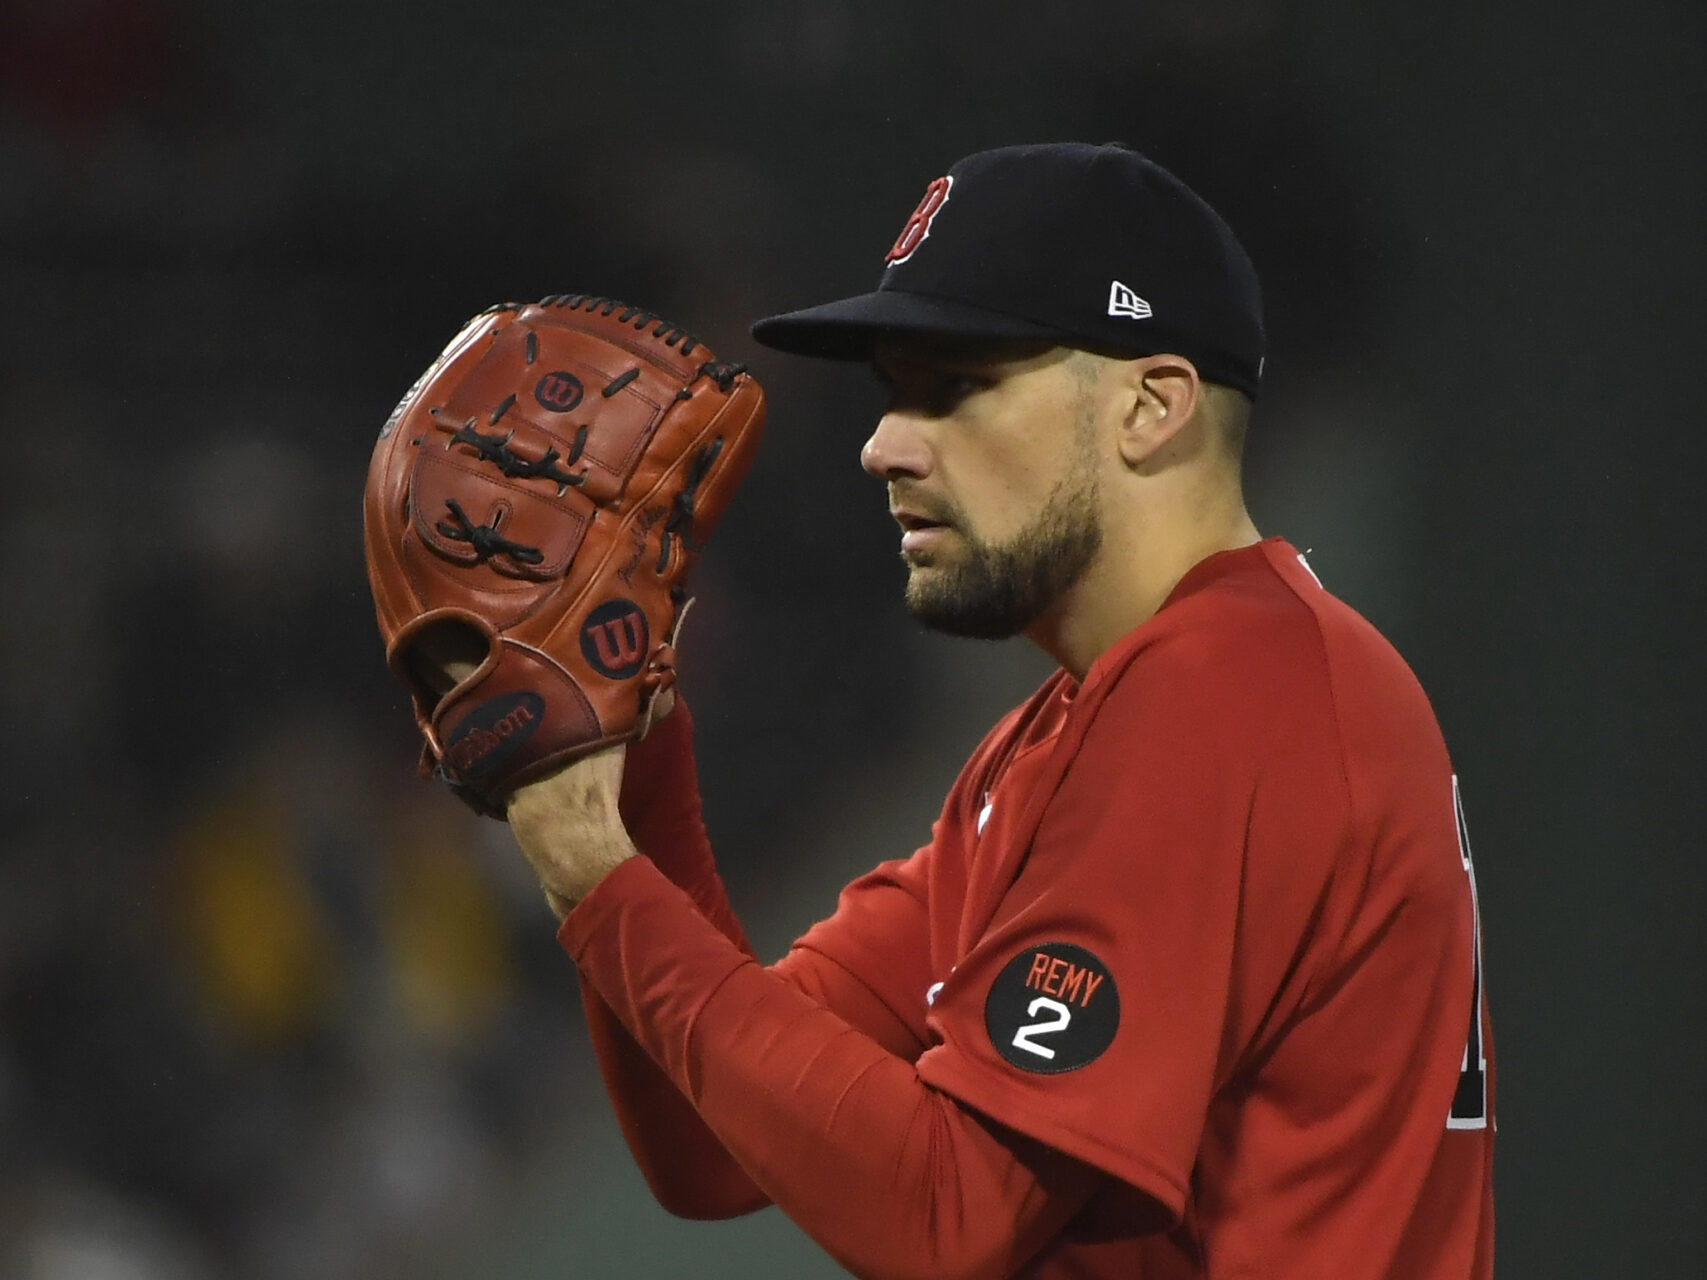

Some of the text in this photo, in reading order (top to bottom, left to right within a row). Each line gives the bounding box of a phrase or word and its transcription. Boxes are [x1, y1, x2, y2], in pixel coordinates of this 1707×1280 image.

[885, 175, 953, 269] B
[542, 375, 579, 407] W
[587, 611, 646, 670] W
[1025, 952, 1104, 1008] REMY
[1011, 996, 1071, 1060] 2
